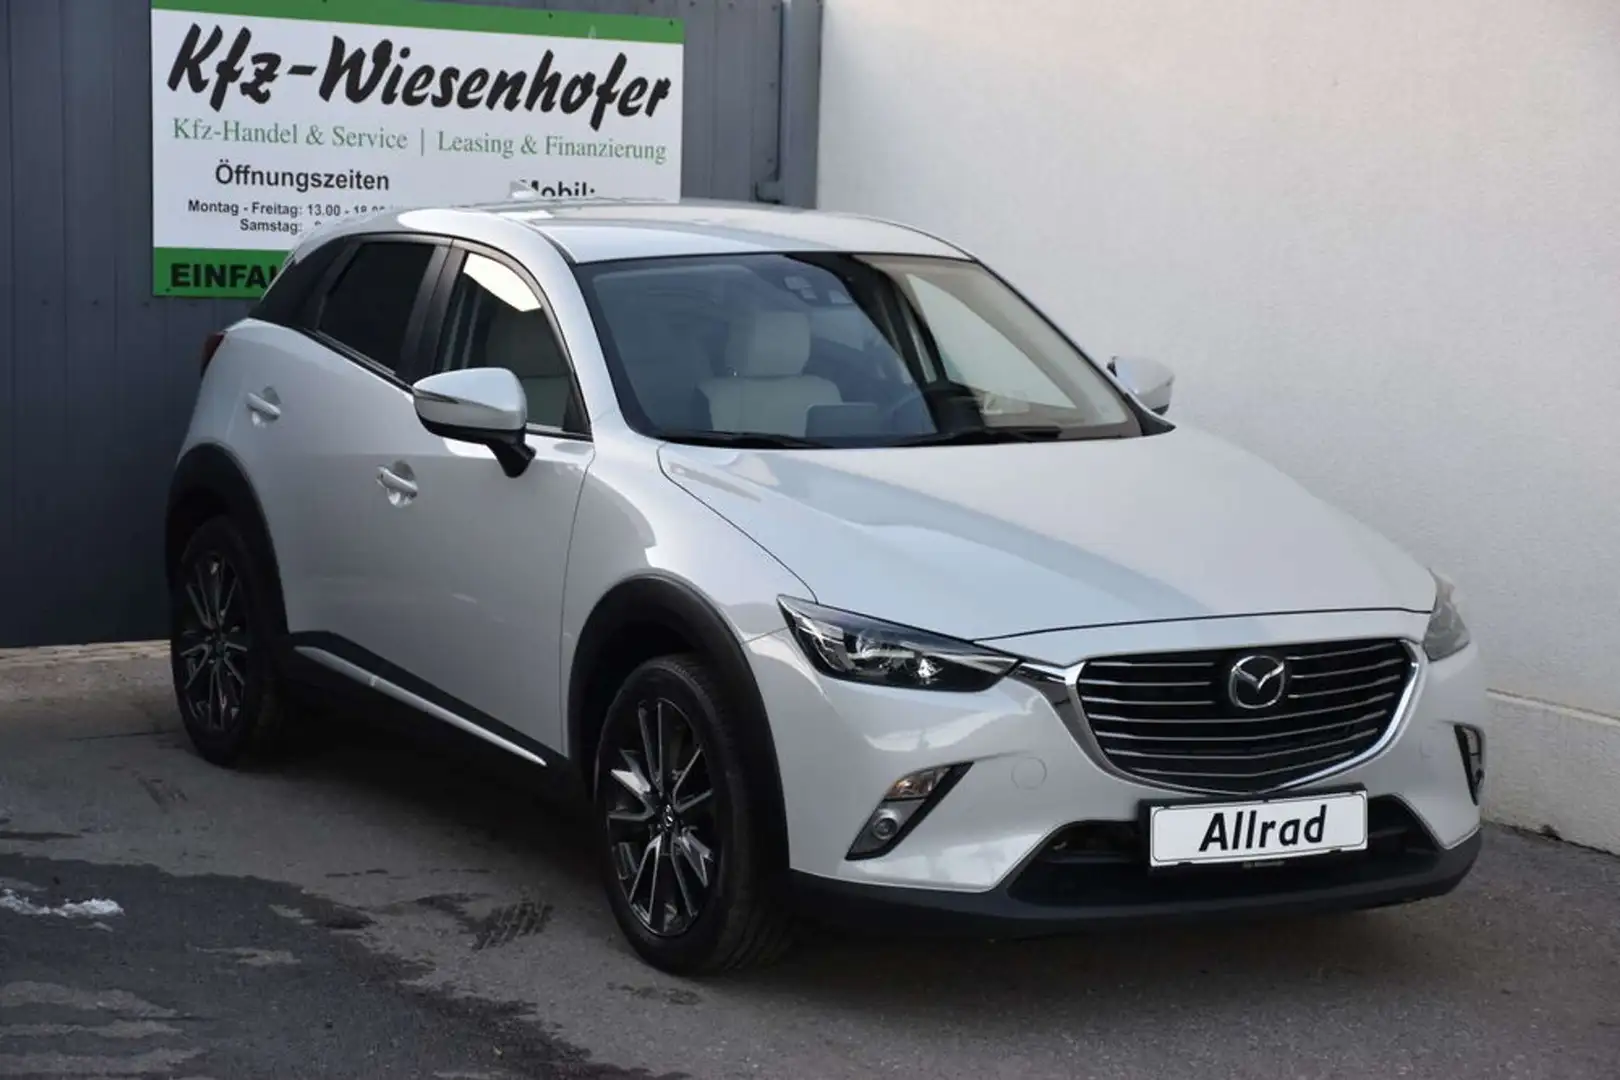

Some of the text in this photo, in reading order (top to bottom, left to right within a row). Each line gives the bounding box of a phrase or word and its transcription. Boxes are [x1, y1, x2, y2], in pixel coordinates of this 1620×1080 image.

[167, 23, 672, 131] Kfz-Wiesenhofer
[173, 117, 298, 145] Kfz-Handel
[306, 124, 324, 146] &
[332, 125, 408, 150] Service
[437, 131, 514, 159] Leasing
[520, 135, 538, 155] &
[545, 136, 667, 165] Finanzierung
[215, 158, 390, 193] Öffnungszeiten
[188, 200, 239, 216] Montag
[252, 202, 302, 218] Freitag:
[308, 204, 341, 217] 13.00
[240, 218, 302, 235] Samstag:
[1199, 804, 1327, 852] Allrad
